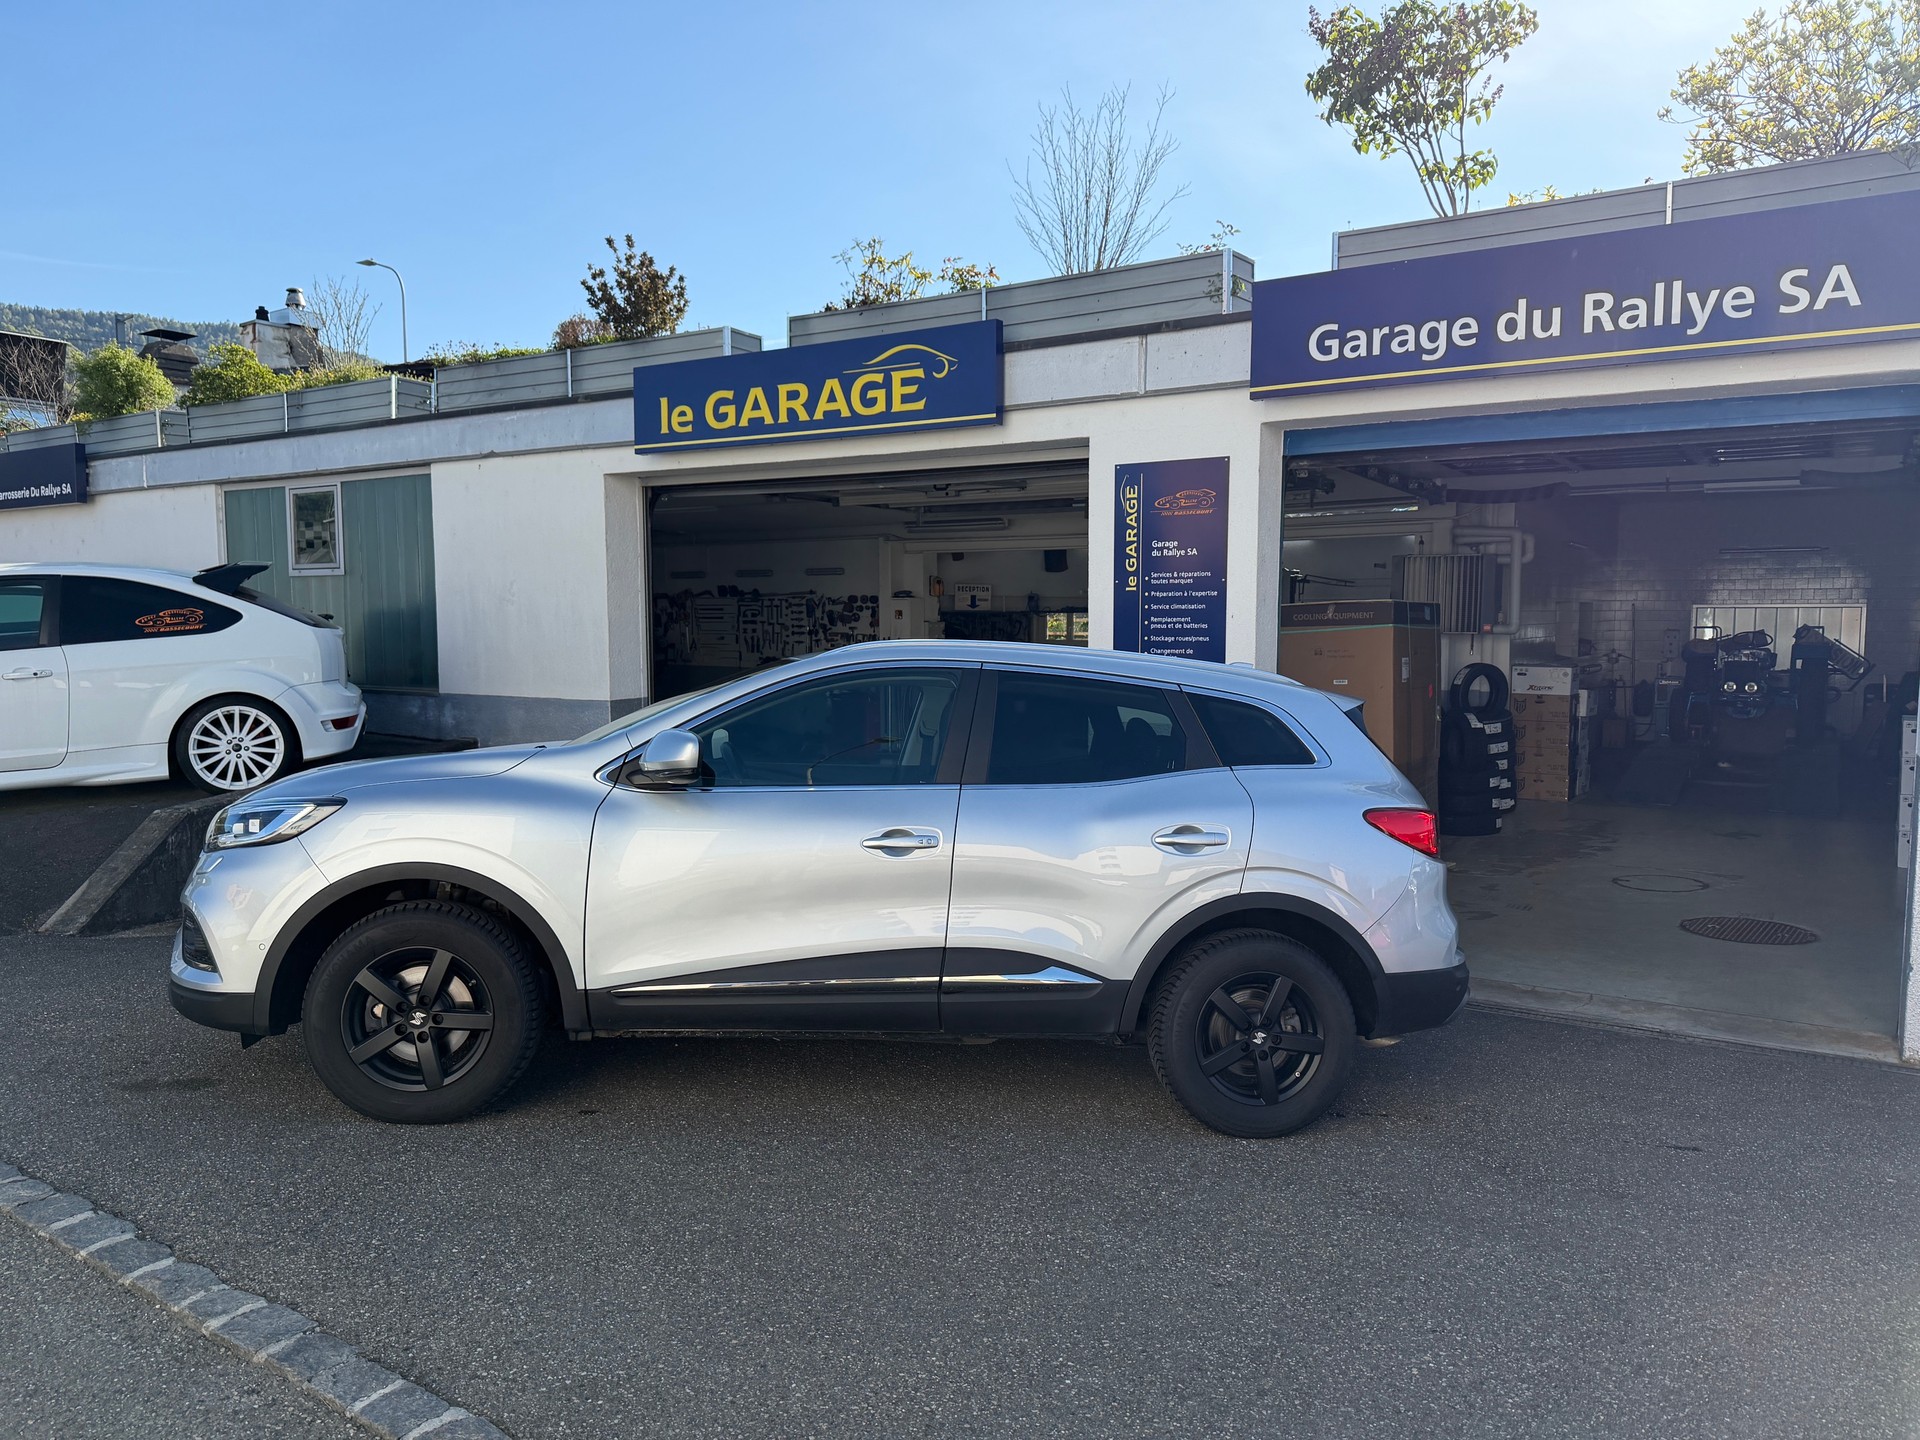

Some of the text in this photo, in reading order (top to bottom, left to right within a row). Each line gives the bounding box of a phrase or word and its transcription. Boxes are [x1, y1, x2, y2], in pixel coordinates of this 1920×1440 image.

[1307, 263, 1862, 362] Garage du Rallye SA
[659, 367, 927, 434] le GARAGE
[30, 486, 40, 498] Du
[40, 483, 61, 499] Rallye
[61, 483, 72, 495] SA
[1125, 484, 1138, 591] le GARAGE
[1151, 540, 1179, 549] Garage
[1151, 547, 1198, 558] du Rallye SA
[957, 585, 990, 593] RECEPTION
[1151, 590, 1183, 598] Préparation
[1293, 611, 1374, 621] COOLING QUIPMENT
